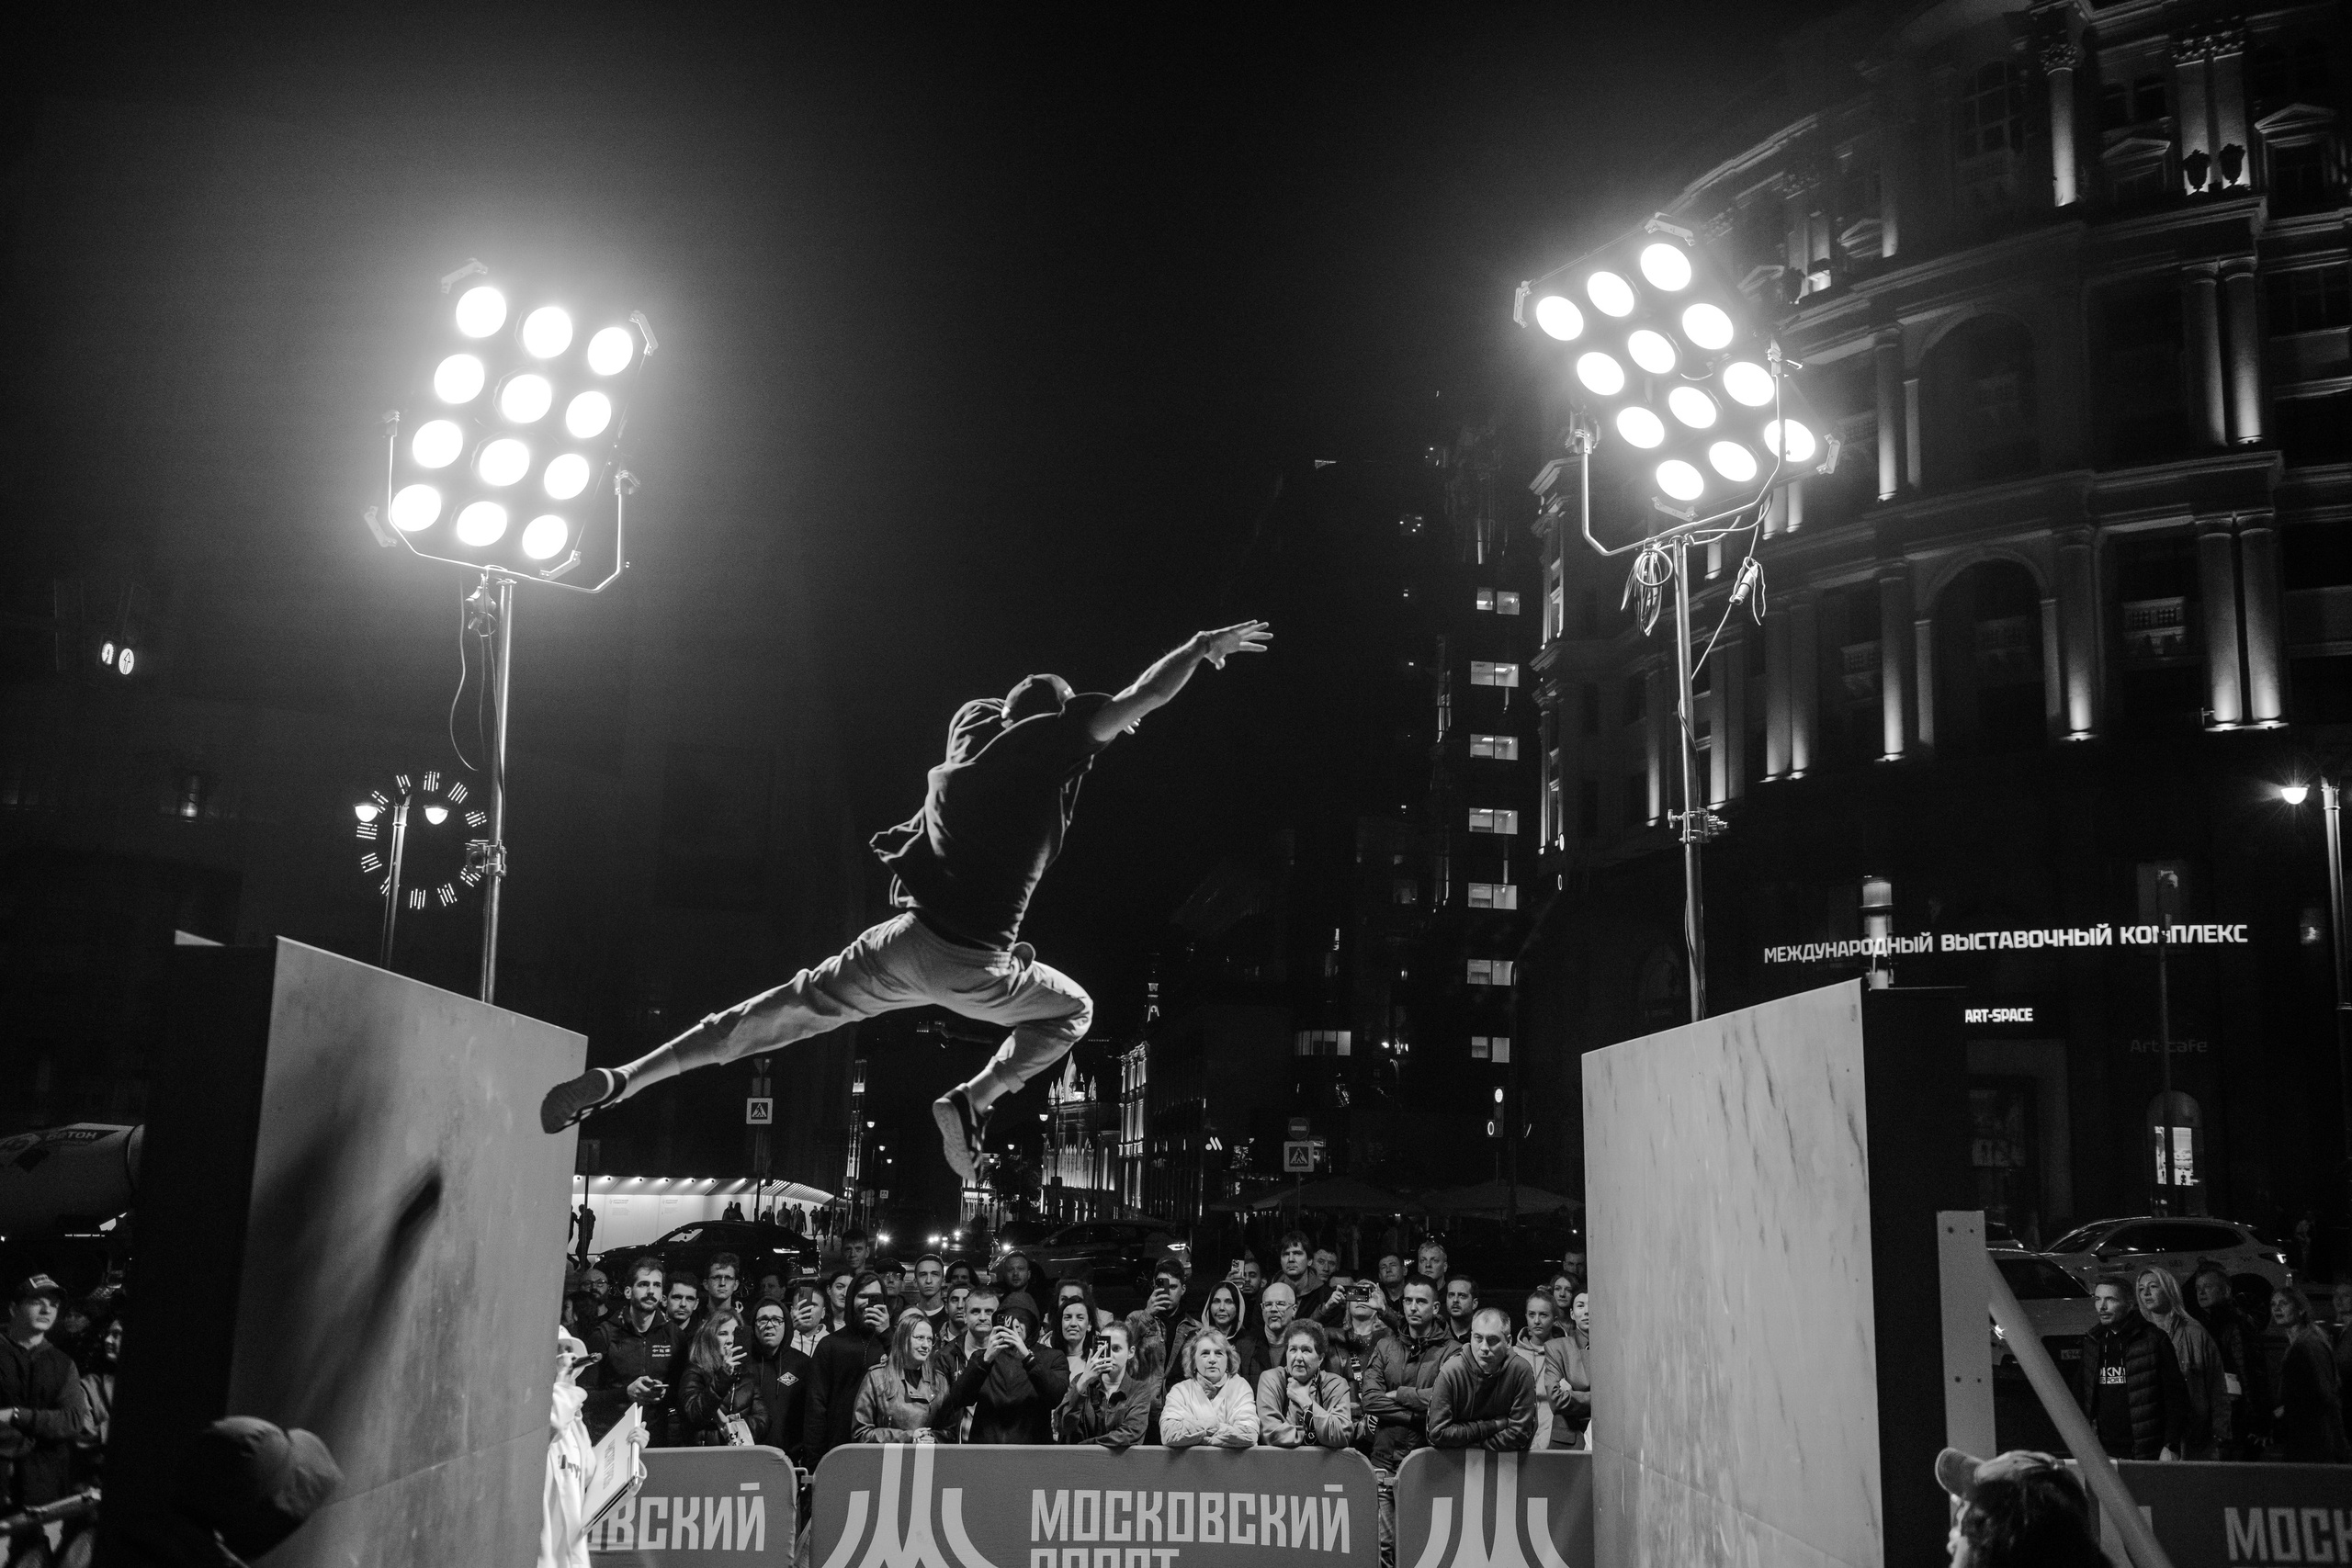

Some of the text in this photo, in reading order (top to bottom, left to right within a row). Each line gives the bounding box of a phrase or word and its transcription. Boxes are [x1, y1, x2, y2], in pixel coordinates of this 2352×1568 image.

[1763, 931, 1933, 964] МЕЖДУНАРОДНЫЙ
[1940, 923, 2112, 952] ВЫСТАВОЧНЫЙ
[1964, 1008, 2034, 1023] ART-SPACE
[1031, 1483, 1351, 1554] МОСКОВСКИЙ
